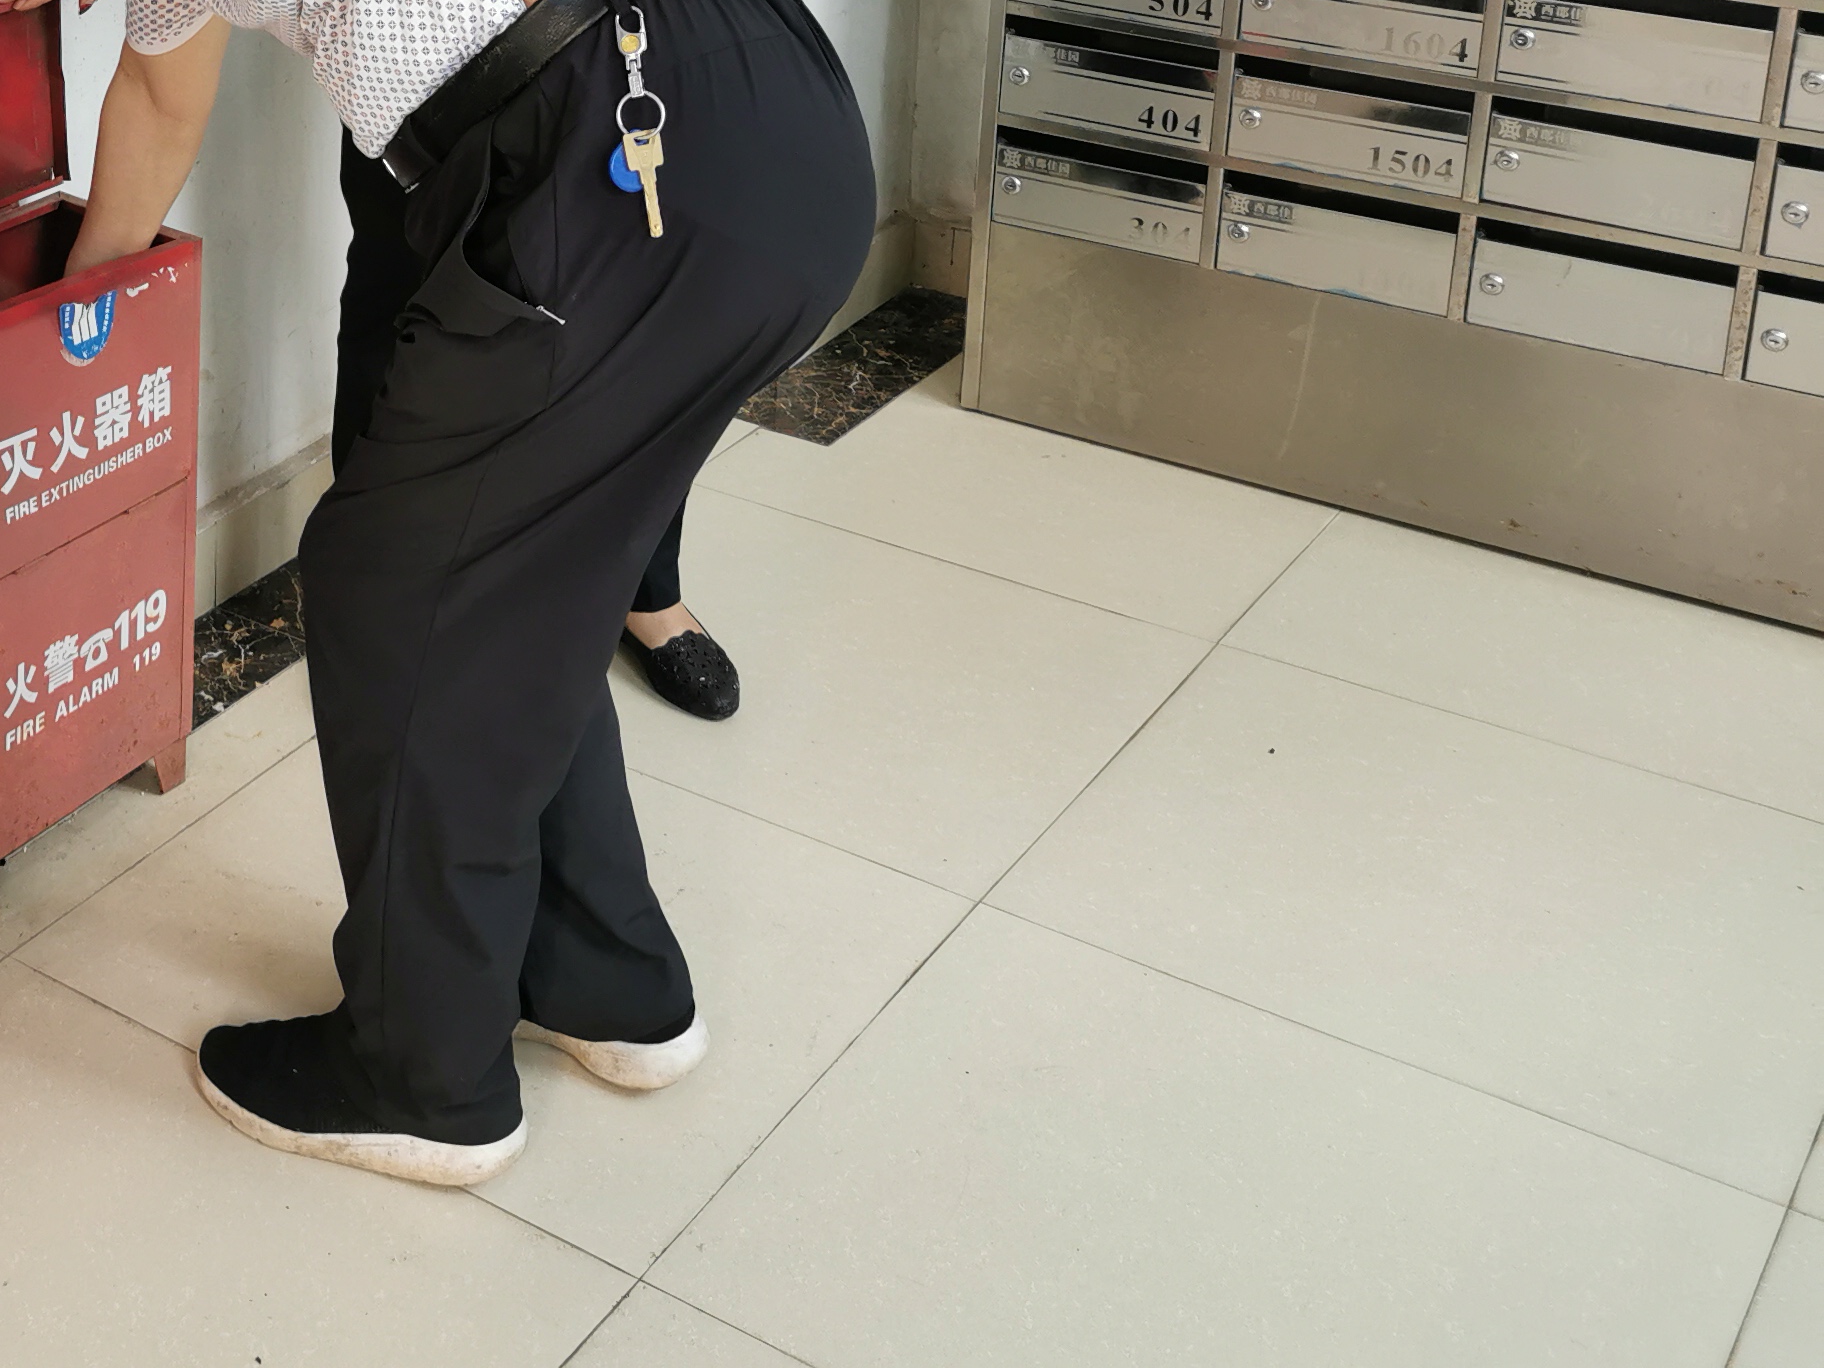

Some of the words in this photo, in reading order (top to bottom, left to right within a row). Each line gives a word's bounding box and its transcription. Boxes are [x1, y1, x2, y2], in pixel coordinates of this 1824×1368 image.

[1380, 26, 1469, 63] 1604
[1138, 106, 1202, 138] 404
[1367, 145, 1454, 183] 1504
[5, 495, 38, 525] FIRE
[41, 444, 144, 508] EXTINGUISHER
[145, 426, 173, 454] BOX
[3, 633, 79, 719] 火警
[114, 588, 168, 652] 119
[5, 710, 46, 752] FIRE
[54, 666, 119, 723] ALARM
[133, 640, 161, 673] 119
